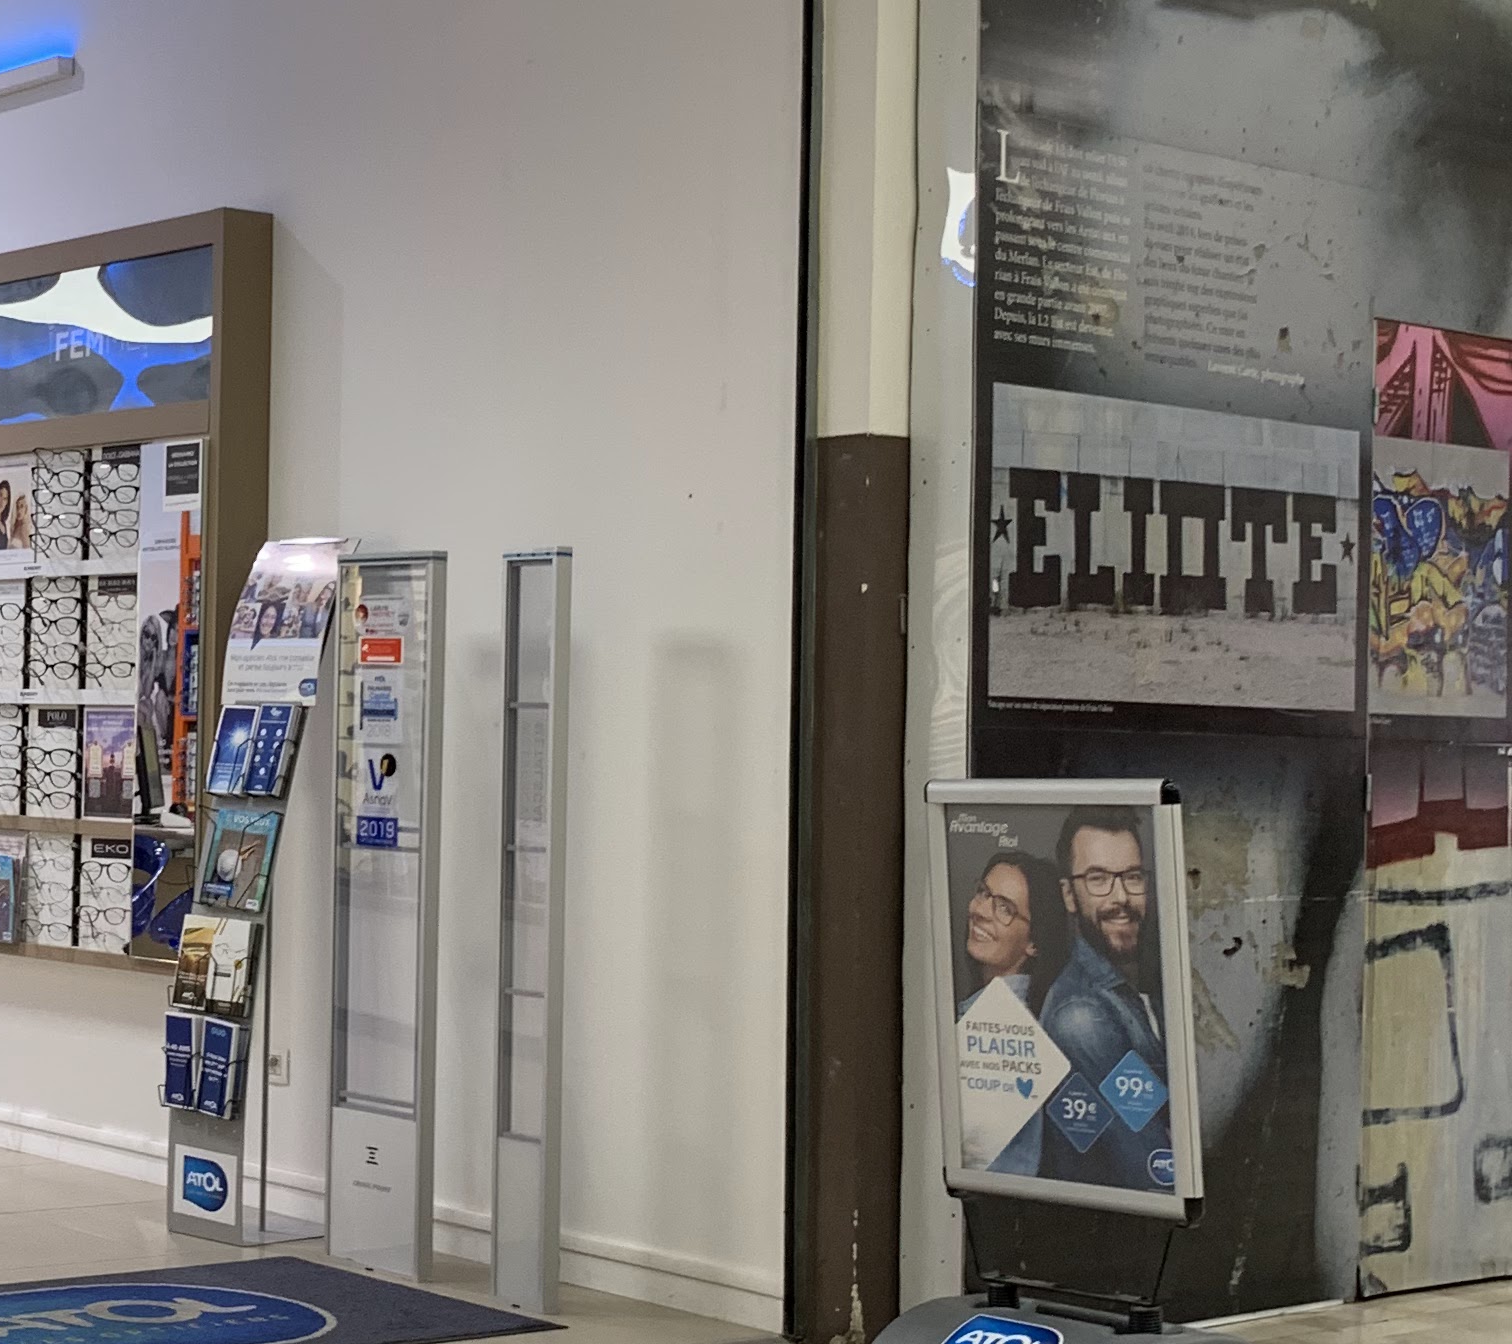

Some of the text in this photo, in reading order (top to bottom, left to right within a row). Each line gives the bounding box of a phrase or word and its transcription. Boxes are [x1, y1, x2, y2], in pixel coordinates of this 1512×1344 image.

[360, 819, 395, 839] 2019
[949, 820, 1008, 836] Avantage
[93, 844, 129, 854] EKO
[966, 1021, 1035, 1036] FAITES-VOUS
[967, 1035, 1036, 1058] PLAISIR
[1002, 1060, 1042, 1074] PACKS
[186, 1171, 223, 1191] ATOL
